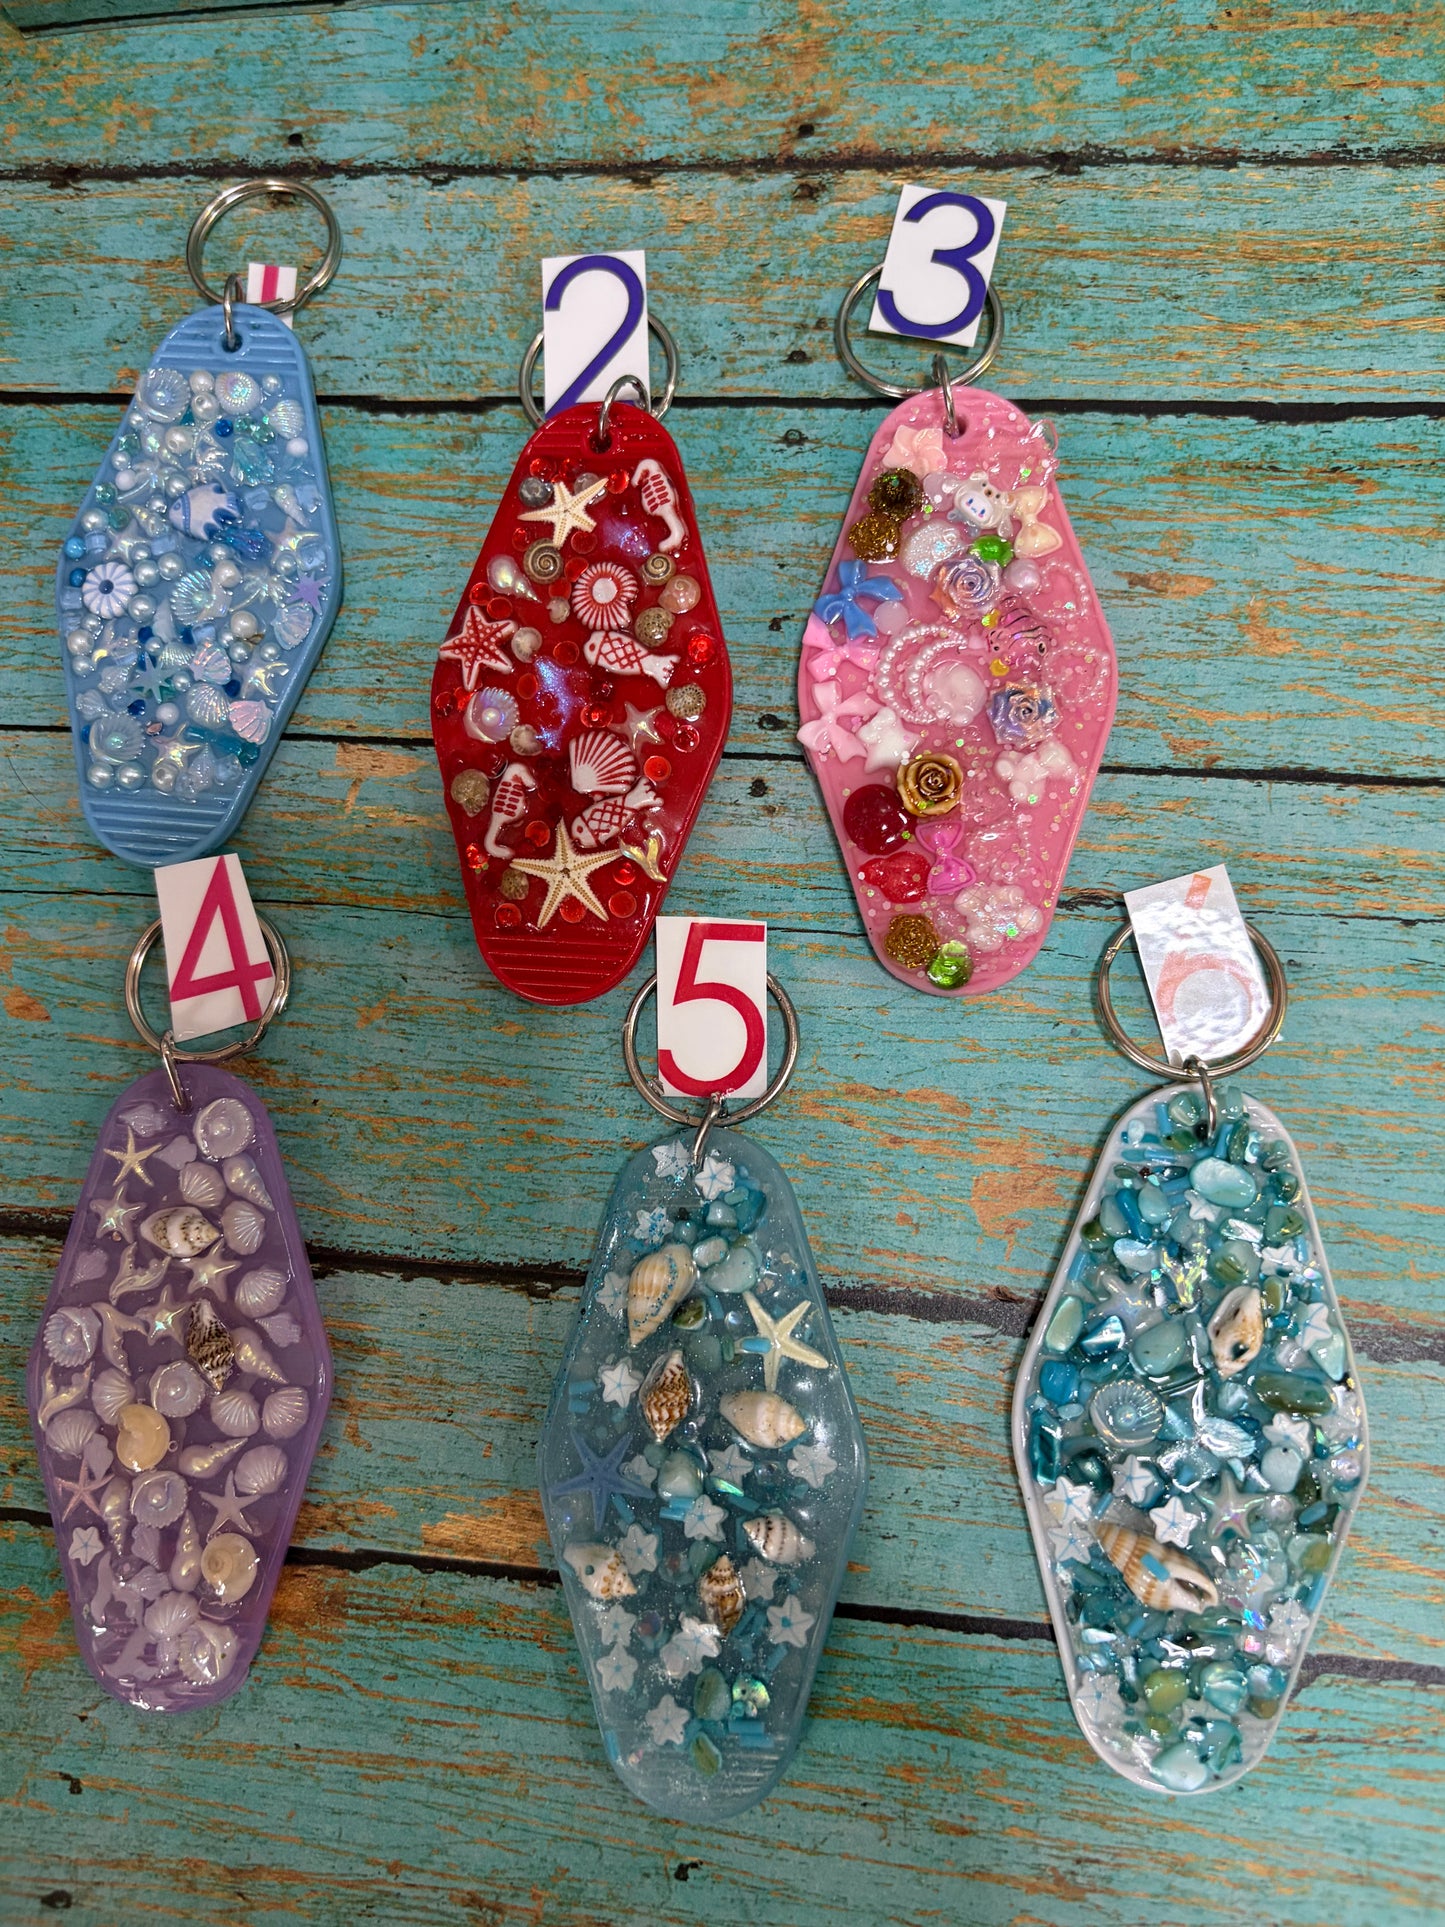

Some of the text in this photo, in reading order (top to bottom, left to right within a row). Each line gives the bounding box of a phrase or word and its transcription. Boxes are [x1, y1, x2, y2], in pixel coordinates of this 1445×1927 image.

[545, 255, 644, 420] 2
[877, 191, 995, 339] 3
[170, 855, 273, 1022] 4
[658, 922, 765, 1098] 5
